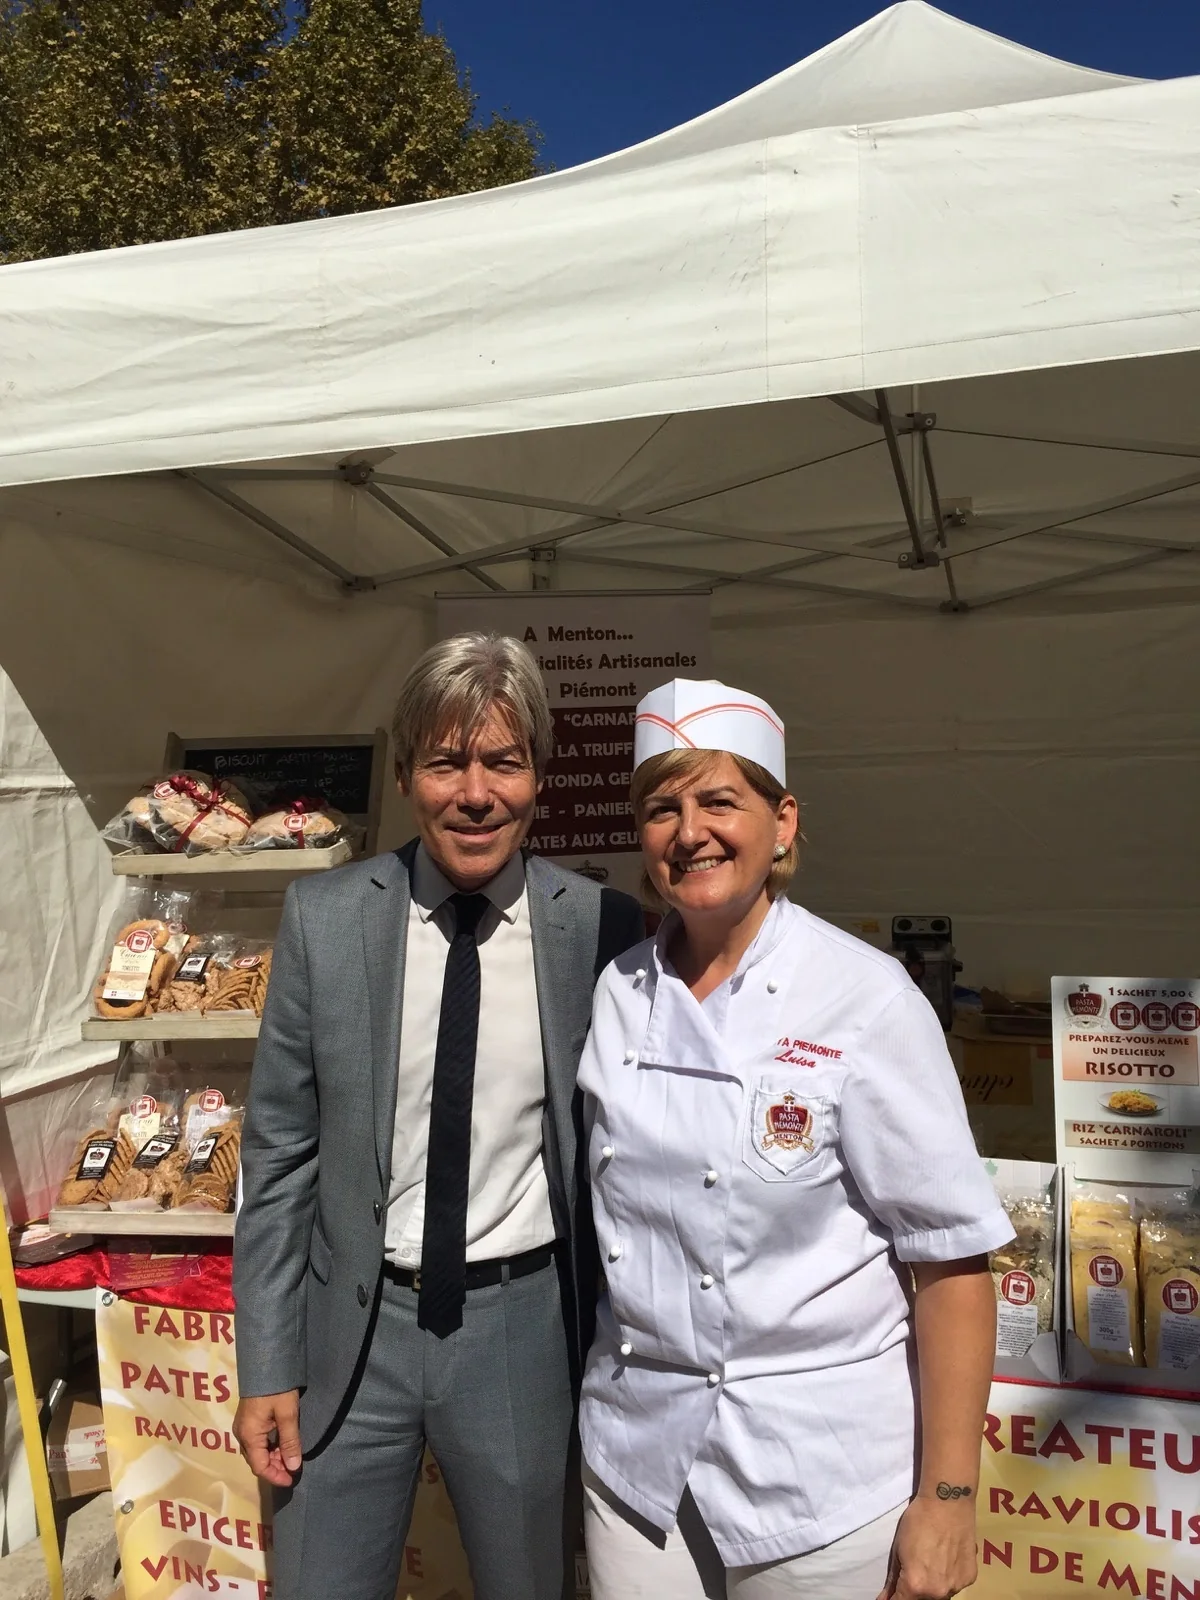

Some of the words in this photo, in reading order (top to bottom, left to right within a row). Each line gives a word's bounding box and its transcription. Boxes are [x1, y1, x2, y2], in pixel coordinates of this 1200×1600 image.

[523, 626, 537, 642] A
[548, 626, 633, 641] Menton...
[534, 653, 593, 671] ialités
[598, 652, 697, 668] Artisanales
[559, 682, 637, 698] Piémont
[557, 744, 579, 758] LA
[534, 806, 550, 819] IE
[571, 832, 605, 847] AUX
[609, 831, 641, 846] ŒU
[1108, 987, 1114, 996] 1
[1117, 989, 1157, 998] SACHET
[1161, 989, 1186, 998] 5,00
[1075, 998, 1095, 1006] PASTA
[1069, 1034, 1155, 1045] PREPAREZ-VOUS
[1157, 1037, 1190, 1046] MEME
[792, 1039, 843, 1060] PIEMONTE
[1092, 1047, 1108, 1055] UN
[1111, 1048, 1166, 1057] DELICIEUX
[774, 1049, 817, 1069] Luisa
[1085, 1061, 1175, 1078] RISOTTO
[778, 1113, 800, 1122] PASTA
[774, 1121, 804, 1132] PIEMONTE
[1072, 1123, 1096, 1134] RIZ
[773, 1133, 804, 1142] MENTON
[1079, 1137, 1119, 1147] SACHET
[1121, 1139, 1127, 1147] 4
[1130, 1139, 1186, 1150] PORTIONS
[120, 1361, 230, 1404] PATES
[135, 1416, 240, 1455] RAVIOL
[1029, 1545, 1084, 1583] DE
